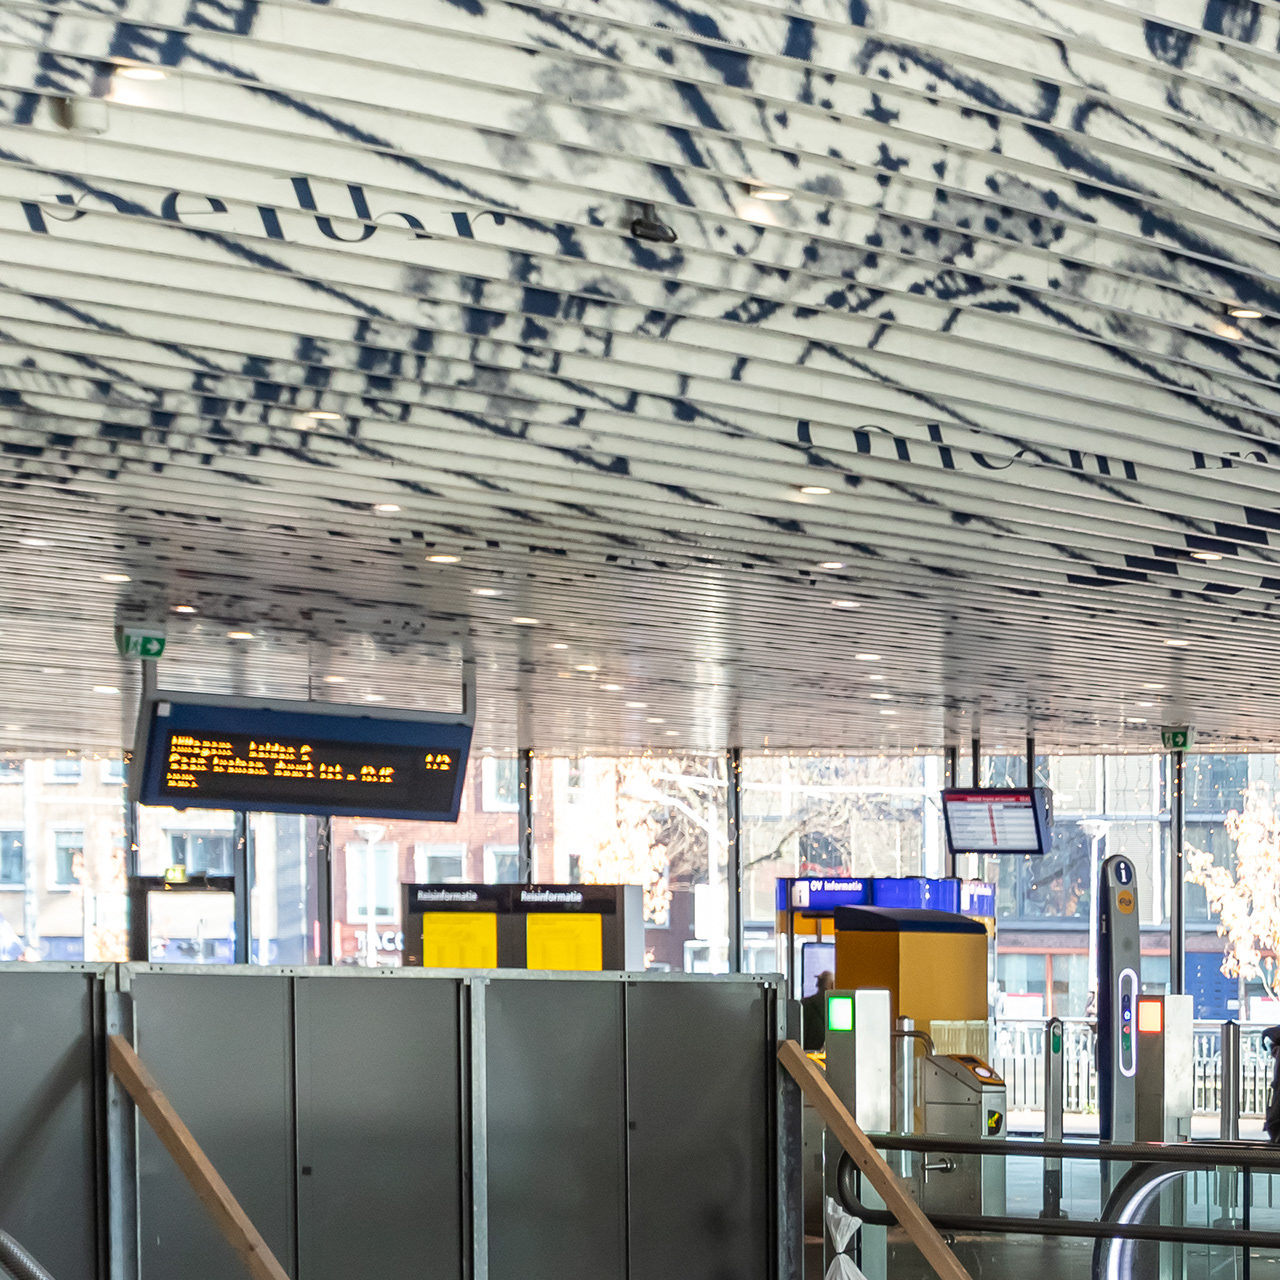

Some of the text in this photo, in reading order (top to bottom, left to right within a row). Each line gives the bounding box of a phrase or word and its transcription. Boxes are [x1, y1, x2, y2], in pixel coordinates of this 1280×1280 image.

[810, 880, 863, 892] OV Informatie
[417, 889, 478, 902] Reisinformatie
[520, 890, 583, 903] Reisinformatie
